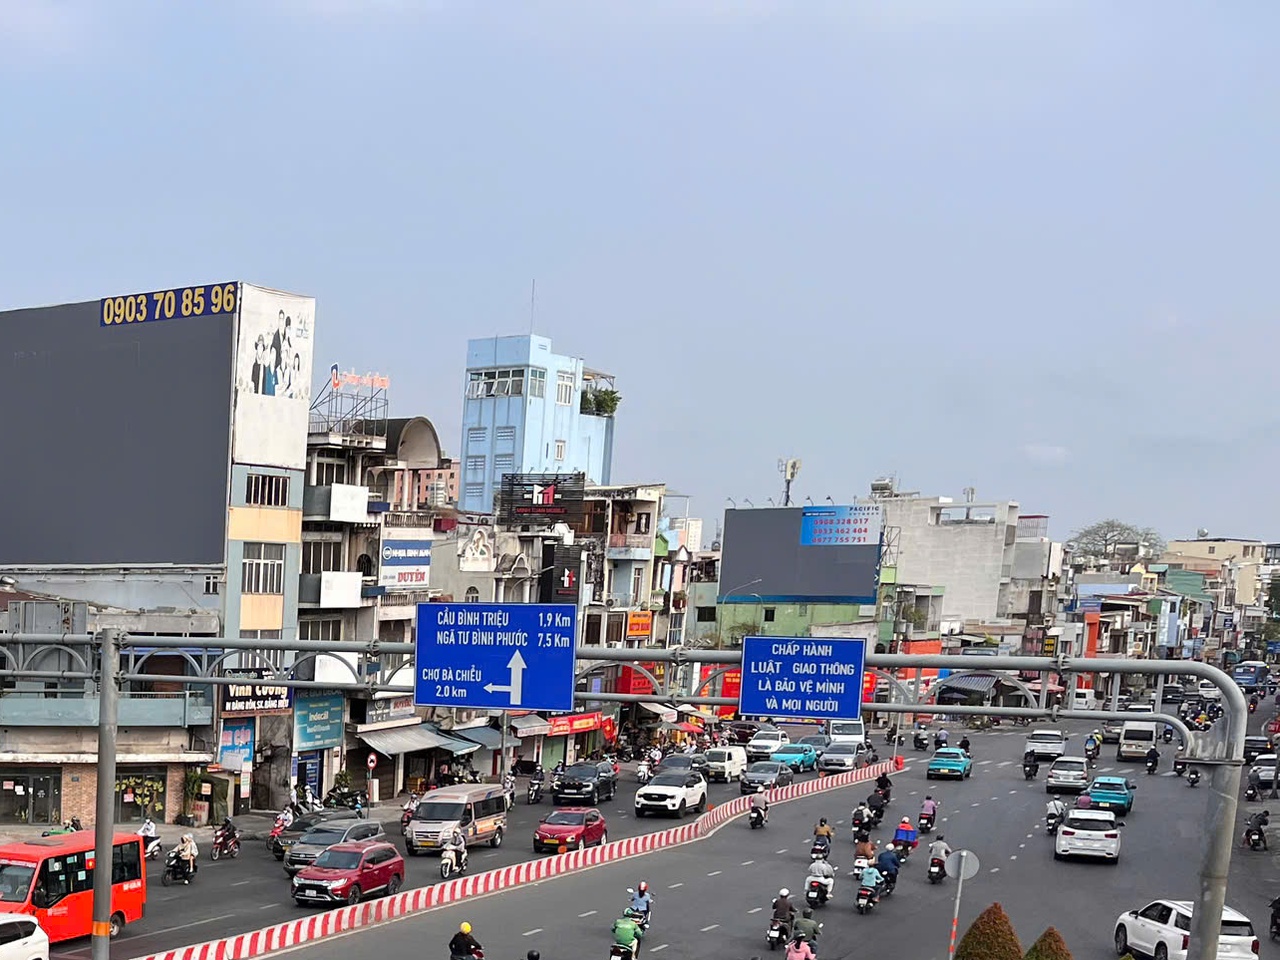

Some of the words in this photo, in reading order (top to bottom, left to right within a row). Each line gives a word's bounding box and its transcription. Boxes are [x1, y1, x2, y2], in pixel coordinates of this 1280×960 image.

[103, 294, 148, 326] 0903
[153, 291, 176, 320] 70
[181, 287, 205, 317] 85
[210, 283, 235, 313] 96
[437, 607, 455, 625] CẦU
[458, 609, 479, 626] BÌNH
[482, 609, 509, 628] TRIỆU
[555, 613, 570, 627] Km
[436, 629, 455, 645] NGÃ
[458, 631, 470, 645] TƯ
[472, 629, 494, 646] BÌNH
[496, 628, 528, 646] PHƯỚC
[554, 633, 569, 648] Km
[772, 641, 800, 655] CHẤP
[803, 642, 832, 656] HÀNH
[422, 668, 440, 682] CHỢ
[442, 667, 454, 681] BÀ
[751, 660, 782, 675] LUẬT
[792, 663, 817, 675] GIAO
[820, 662, 854, 675] THÔNG
[435, 685, 450, 698] 2.0
[451, 686, 467, 697] km
[758, 677, 772, 691] LÀ
[775, 677, 796, 692] BẢO
[800, 680, 813, 694] VỆ
[816, 679, 845, 694] MÌNH
[766, 696, 778, 709] VÀ
[782, 699, 801, 712] MỌI
[805, 697, 839, 712] NGƯỜI
